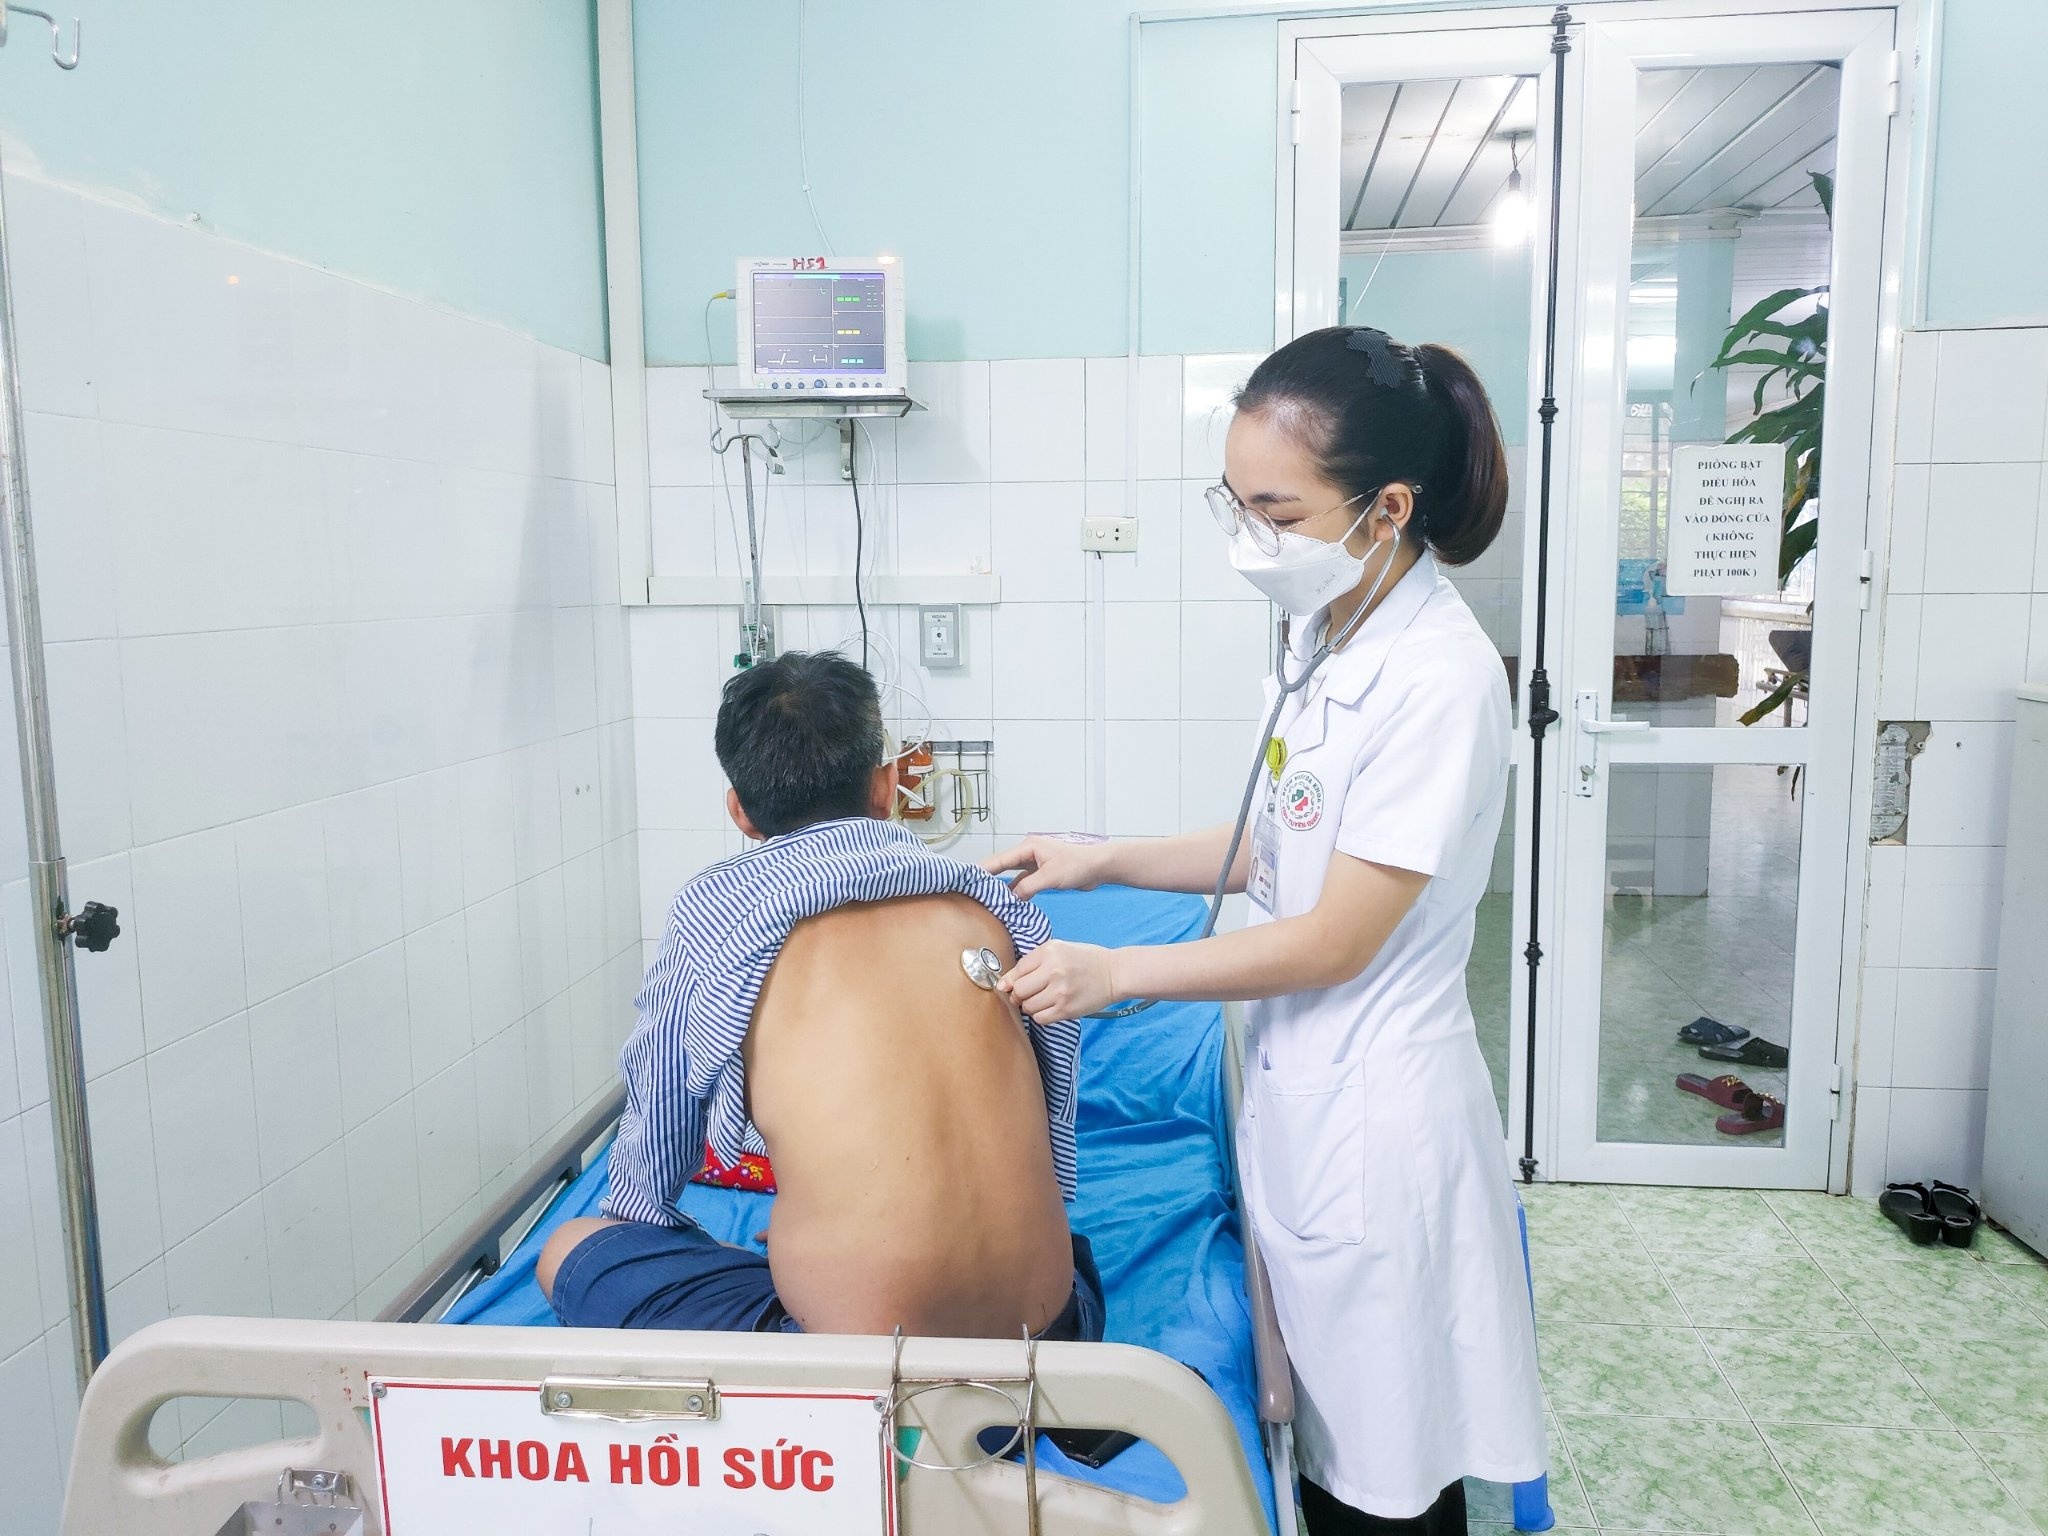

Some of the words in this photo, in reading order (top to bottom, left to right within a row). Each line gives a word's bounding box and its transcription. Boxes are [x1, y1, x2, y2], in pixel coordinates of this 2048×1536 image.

[1698, 459, 1738, 470] PHÒNG
[1717, 496, 1746, 507] NGHỊ
[1749, 496, 1764, 505] RA
[1685, 513, 1709, 524] VÀO
[1694, 550, 1727, 561] THỰC
[1693, 568, 1724, 579] PHẠT
[441, 1436, 591, 1483] KHOA
[608, 1433, 701, 1487] HỒI
[722, 1438, 835, 1492] SỨC
